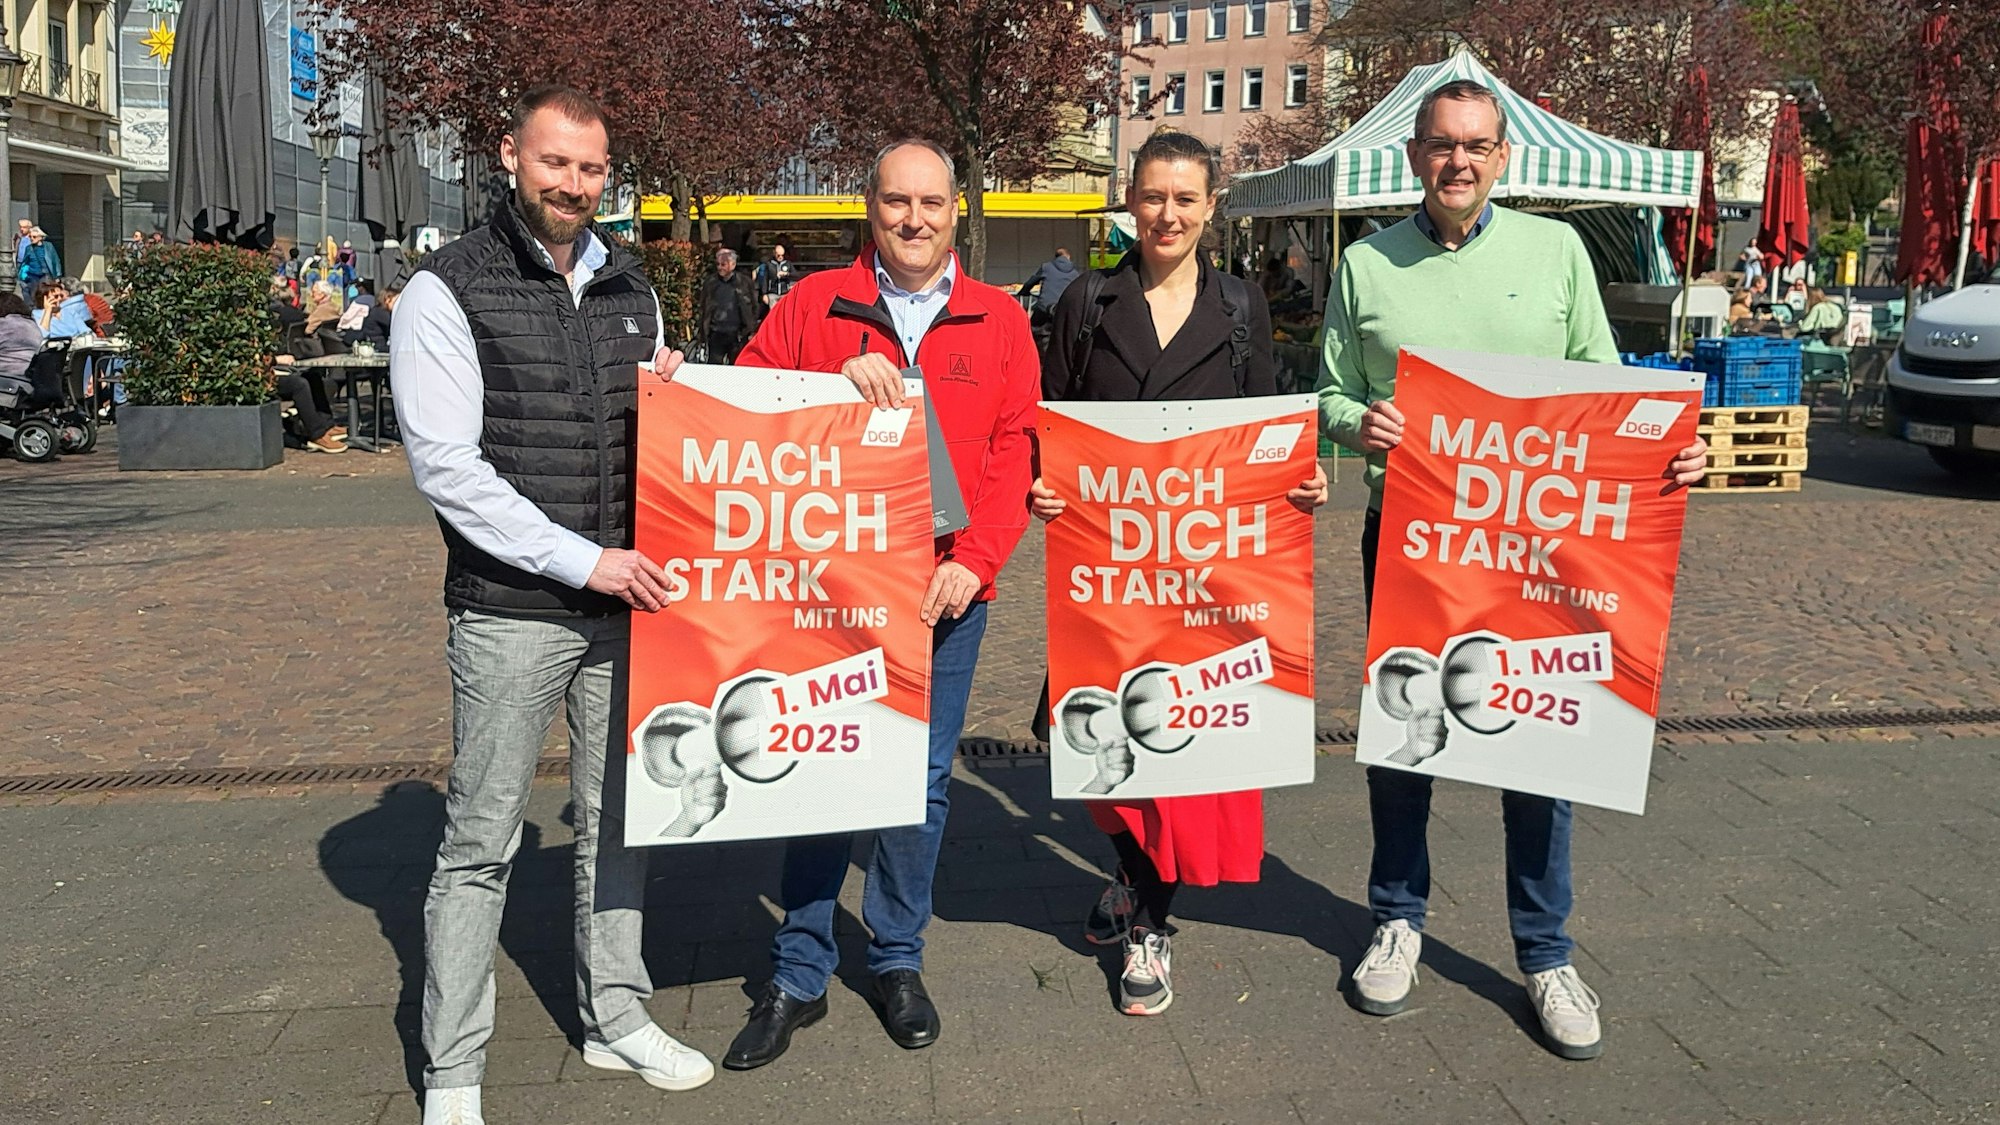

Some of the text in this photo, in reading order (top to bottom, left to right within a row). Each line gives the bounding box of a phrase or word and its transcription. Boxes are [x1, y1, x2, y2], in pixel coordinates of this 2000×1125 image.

[867, 430, 899, 444] DGB
[1429, 414, 1589, 473] MACH
[1625, 421, 1662, 436] DGB
[682, 437, 841, 487] MACH
[1255, 447, 1287, 460] DGB
[1077, 465, 1225, 506] MACH
[1452, 462, 1632, 541] DICH
[713, 489, 888, 552] DICH
[1109, 504, 1267, 563] DICH
[1402, 519, 1563, 578] STARK
[663, 557, 831, 602] STARK
[1068, 565, 1215, 606] STARK
[1521, 579, 1620, 614] MIT UNS
[793, 606, 888, 629] MIT UNS
[1184, 602, 1270, 628] MIT UNS
[1167, 648, 1265, 699] 1. Mai
[1495, 642, 1603, 677] 1. Mai
[771, 659, 879, 716] 1. Mai
[1487, 682, 1581, 726] 2025
[1167, 703, 1250, 729] 2025
[767, 724, 861, 753] 2025
